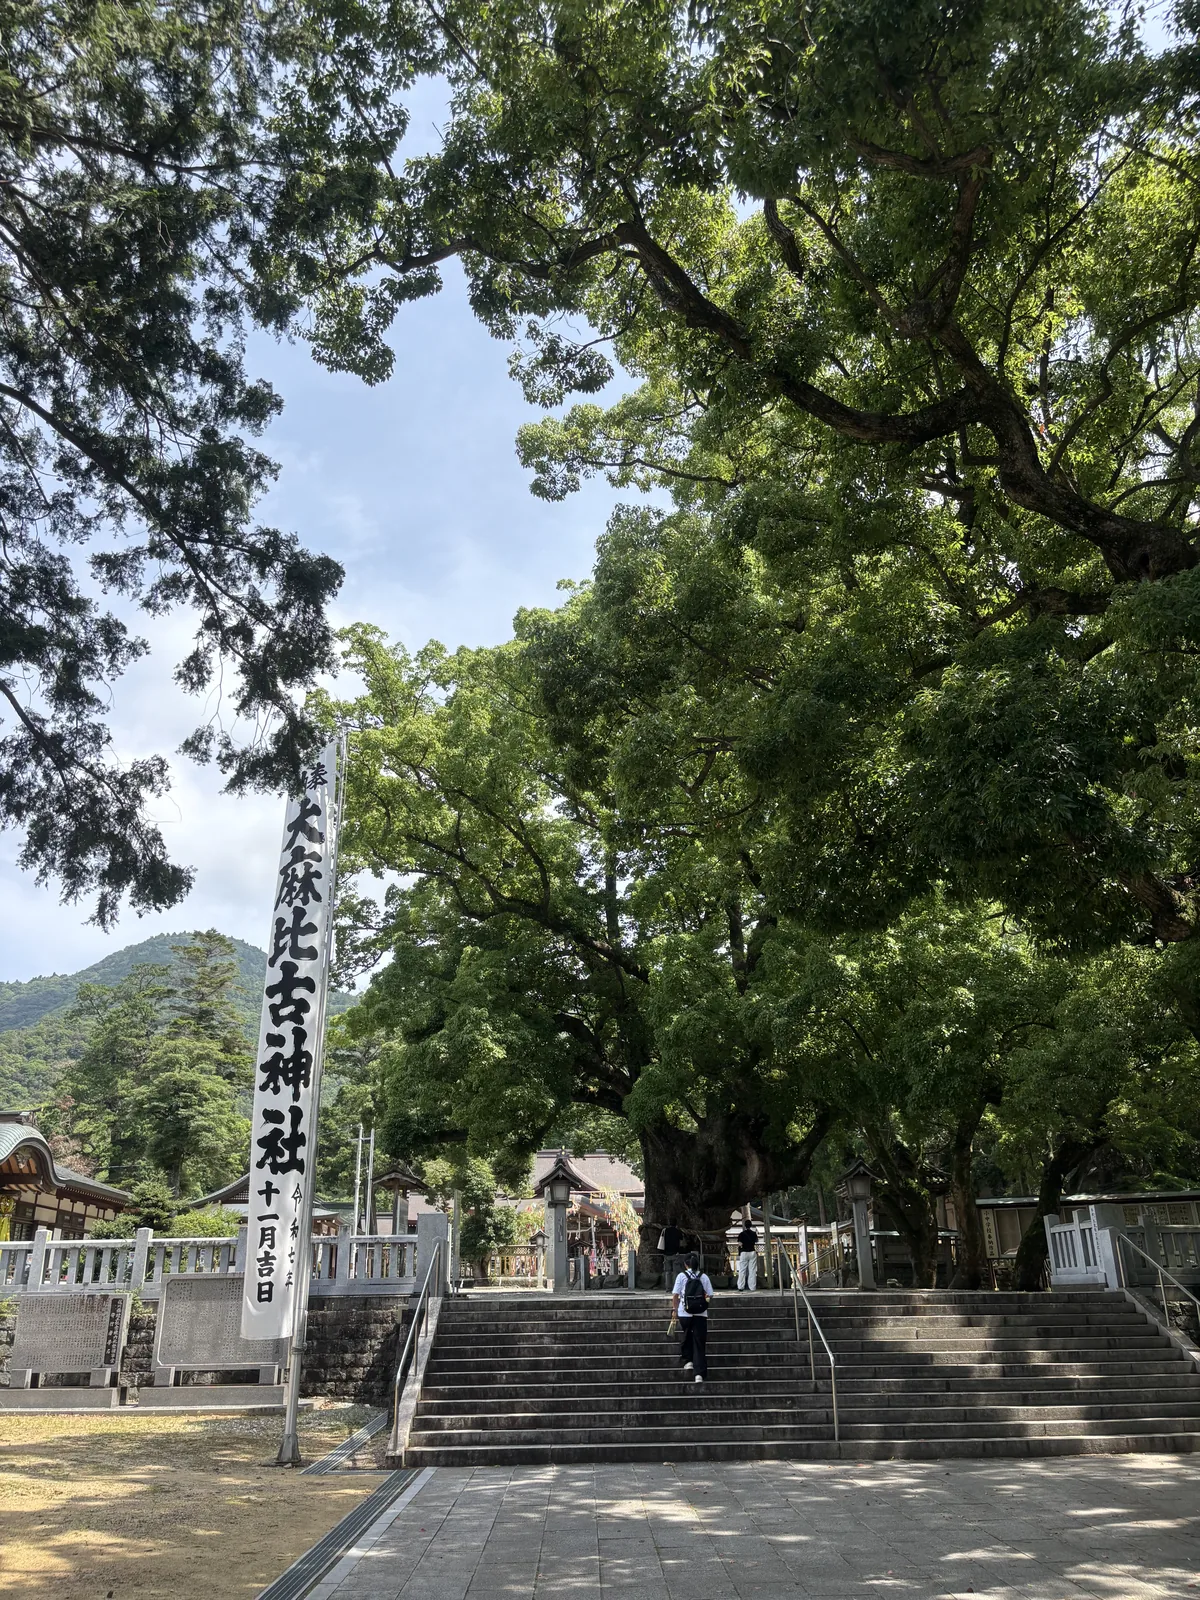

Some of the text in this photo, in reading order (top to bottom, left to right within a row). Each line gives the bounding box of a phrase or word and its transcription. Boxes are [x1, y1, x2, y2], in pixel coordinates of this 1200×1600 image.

[255, 797, 326, 1175] 大麻比古神社
[256, 1180, 281, 1303] 十一月吉日
[284, 1182, 303, 1293] 令和七年
